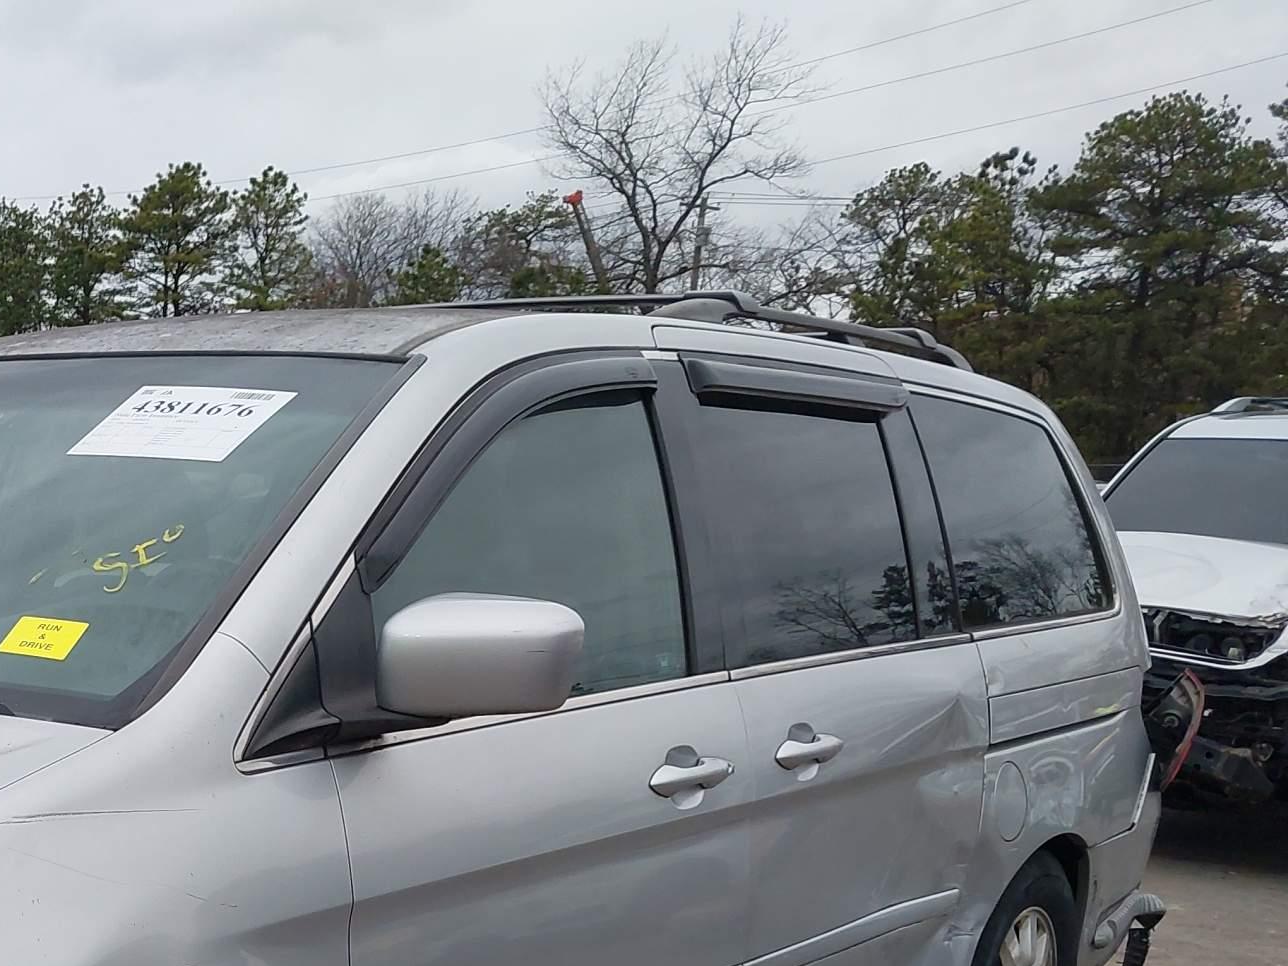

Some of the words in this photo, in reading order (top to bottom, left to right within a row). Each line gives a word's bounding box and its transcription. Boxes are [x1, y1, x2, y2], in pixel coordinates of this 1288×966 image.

[132, 400, 259, 417] 43811676
[37, 623, 63, 632] RUN
[18, 640, 54, 651] DRIVE
